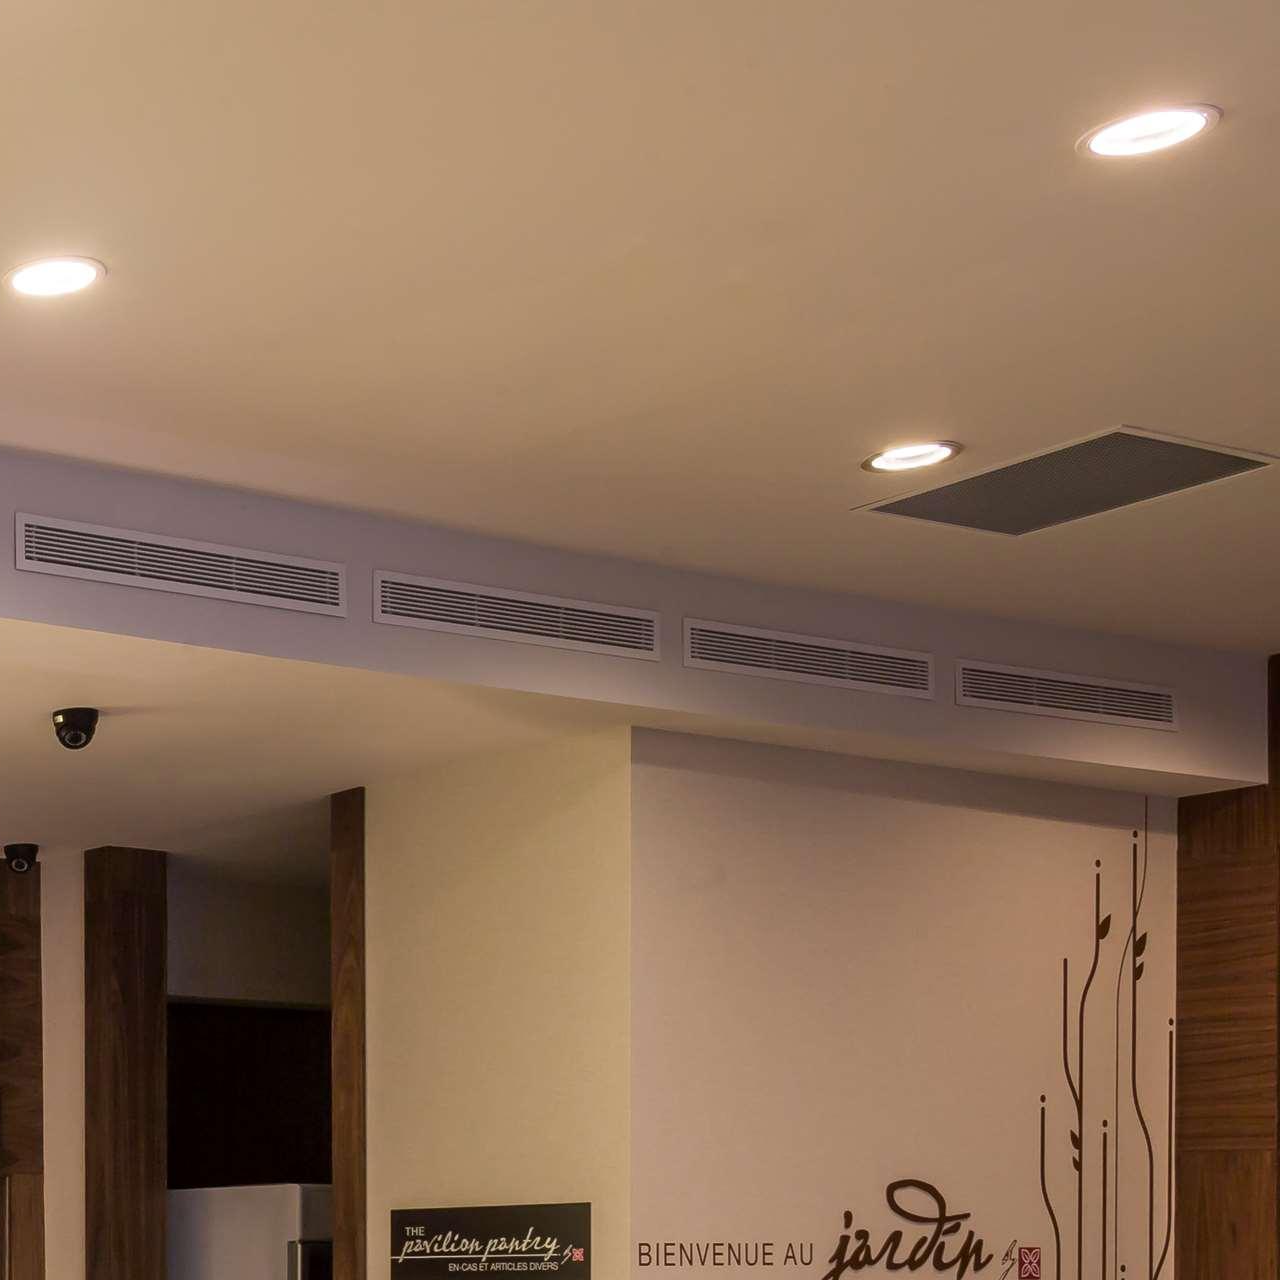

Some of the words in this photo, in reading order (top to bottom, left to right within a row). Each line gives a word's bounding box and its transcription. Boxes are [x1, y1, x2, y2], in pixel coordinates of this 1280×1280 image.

[405, 1226, 425, 1237] THE
[398, 1231, 483, 1263] pavilion
[481, 1226, 560, 1262] pantry
[638, 1242, 774, 1267] BIENVENUE
[783, 1242, 815, 1267] AU
[448, 1263, 479, 1272] EN-CAS
[479, 1263, 489, 1271] ET
[490, 1262, 528, 1271] ARTICLES
[529, 1262, 559, 1271] DIVERS
